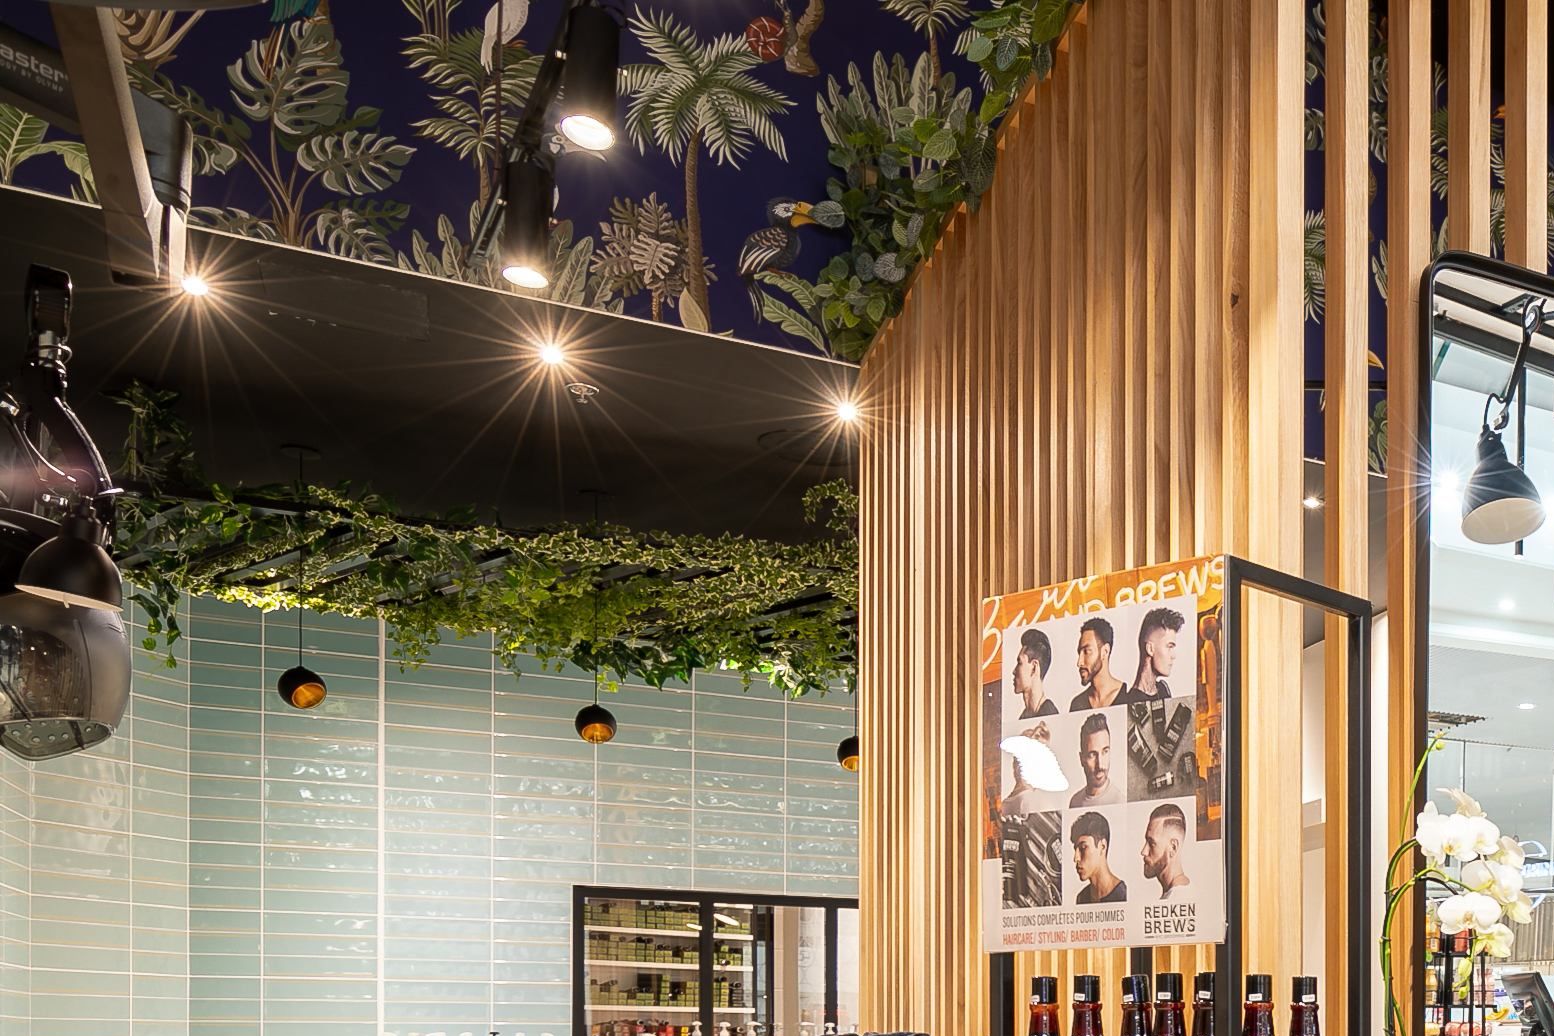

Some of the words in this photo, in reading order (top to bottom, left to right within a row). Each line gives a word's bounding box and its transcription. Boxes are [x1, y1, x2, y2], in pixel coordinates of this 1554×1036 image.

[0, 44, 64, 82] aster
[1144, 903, 1196, 918] REDKEN
[1002, 914, 1036, 928] SOLUTIONS
[1076, 911, 1094, 924] POUR
[1095, 909, 1125, 923] HOMMES
[1102, 927, 1125, 940] COLOR
[1144, 919, 1196, 934] BREWS
